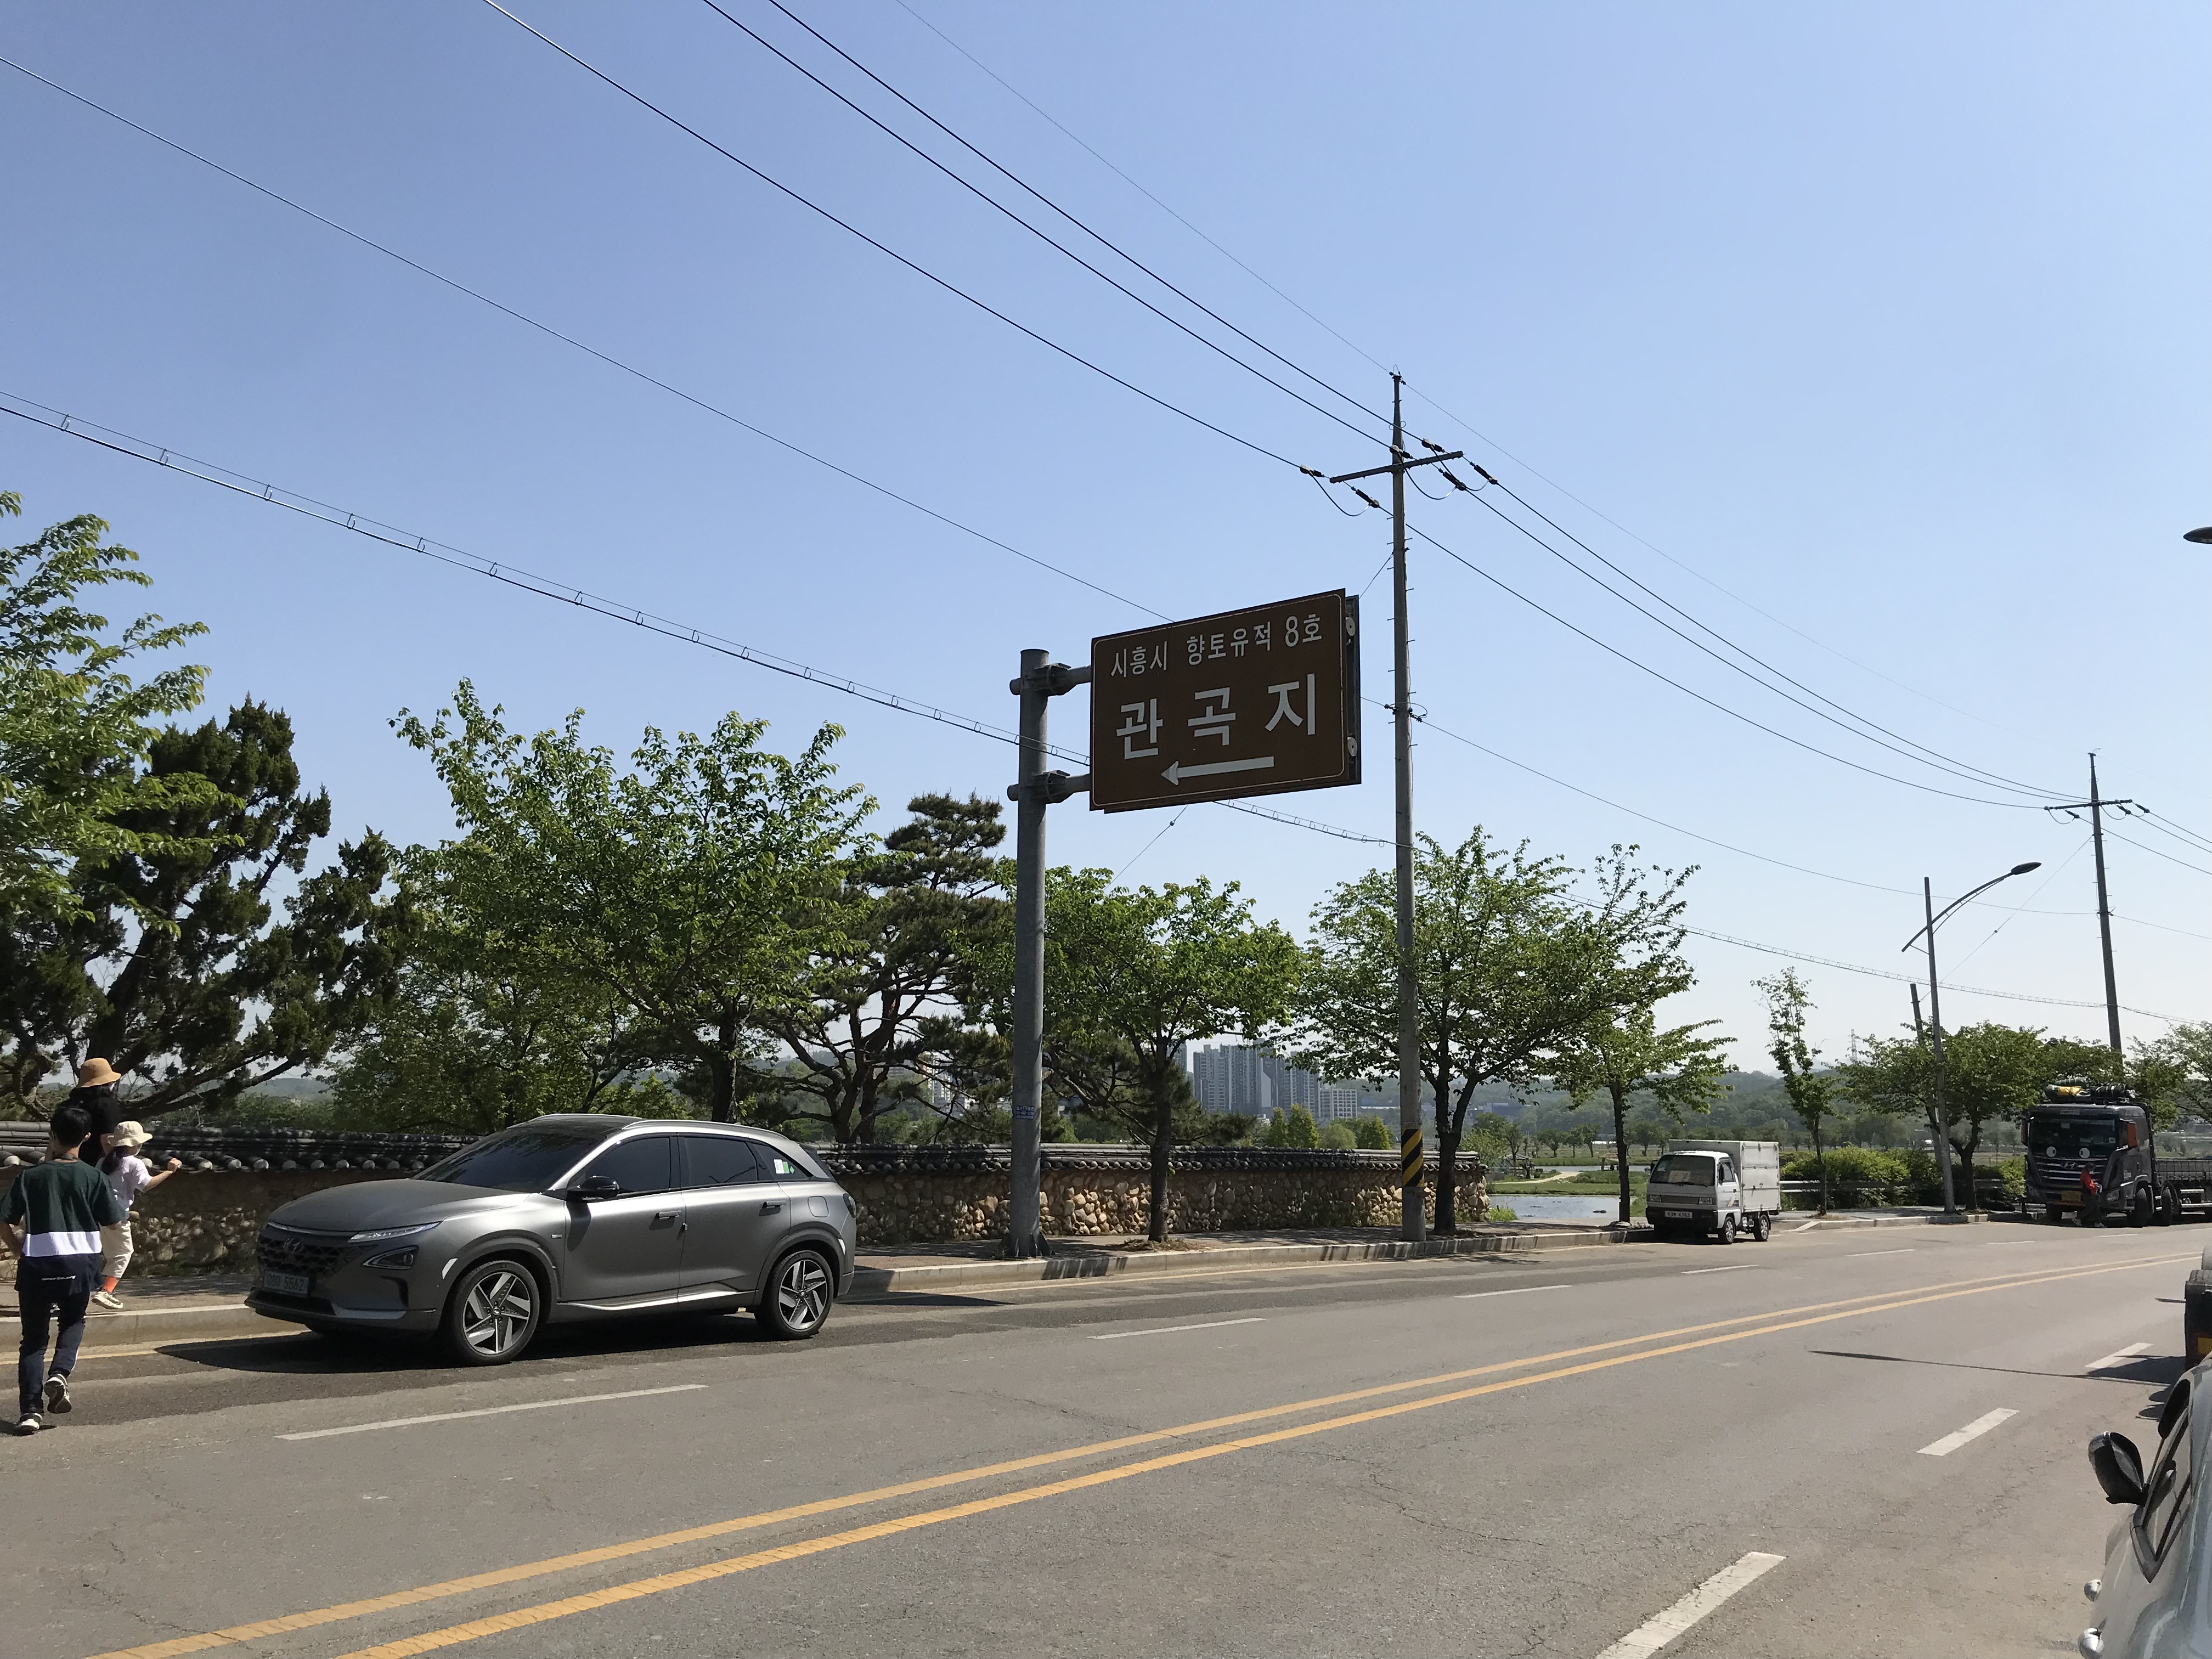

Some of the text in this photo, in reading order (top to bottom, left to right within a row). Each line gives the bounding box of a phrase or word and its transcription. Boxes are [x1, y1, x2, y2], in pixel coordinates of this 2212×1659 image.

[1111, 613, 1322, 678] 시흥시 향토유적 8호
